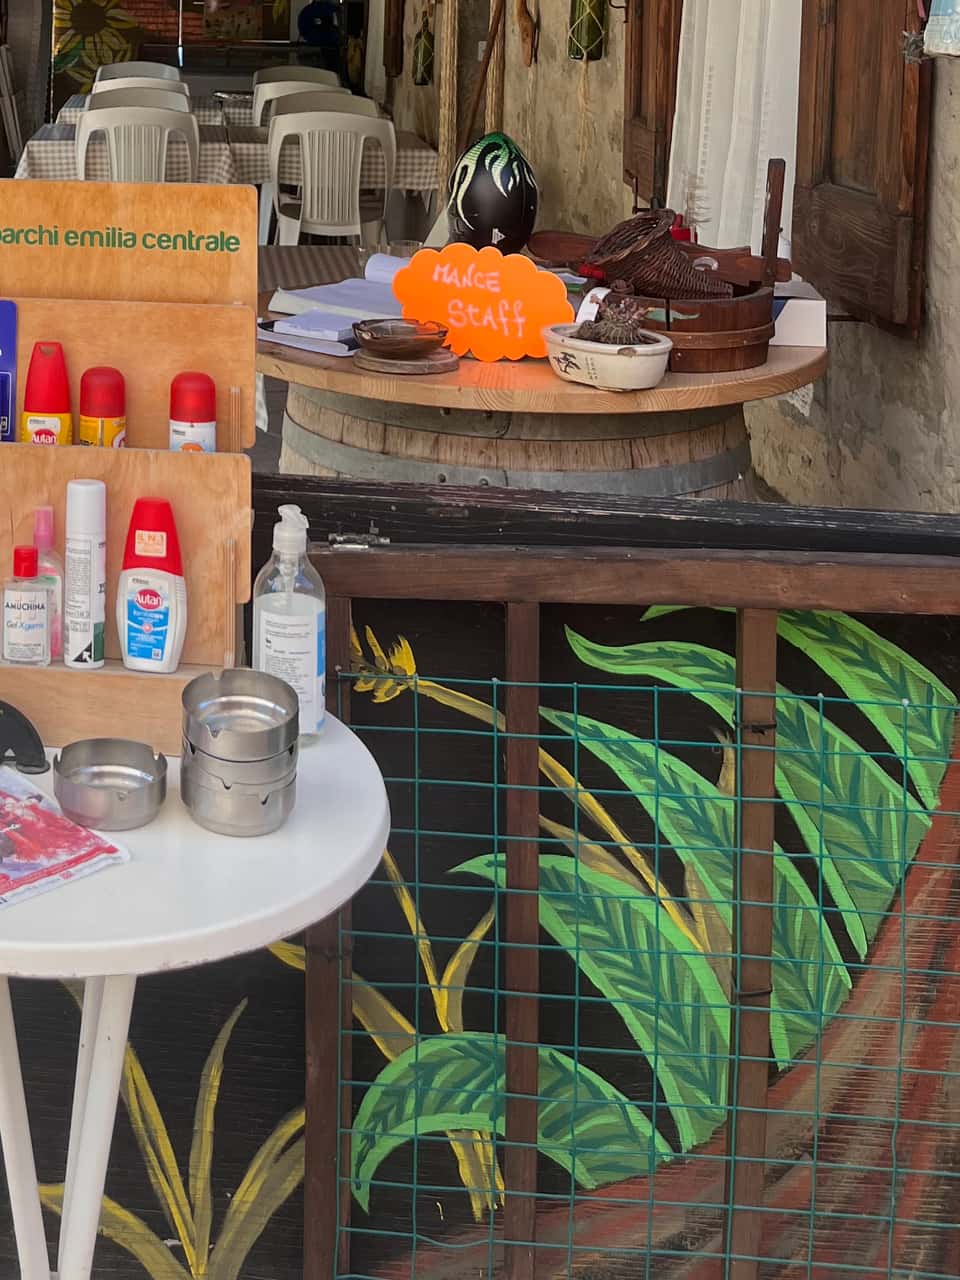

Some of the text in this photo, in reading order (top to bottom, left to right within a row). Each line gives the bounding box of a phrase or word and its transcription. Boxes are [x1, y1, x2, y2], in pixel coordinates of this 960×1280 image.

[64, 227, 137, 248] emilia
[141, 230, 240, 252] centrale
[432, 263, 501, 292] MANCE
[32, 431, 58, 445] Autan
[5, 602, 46, 610] AMUCHINA
[135, 593, 162, 606] Autan
